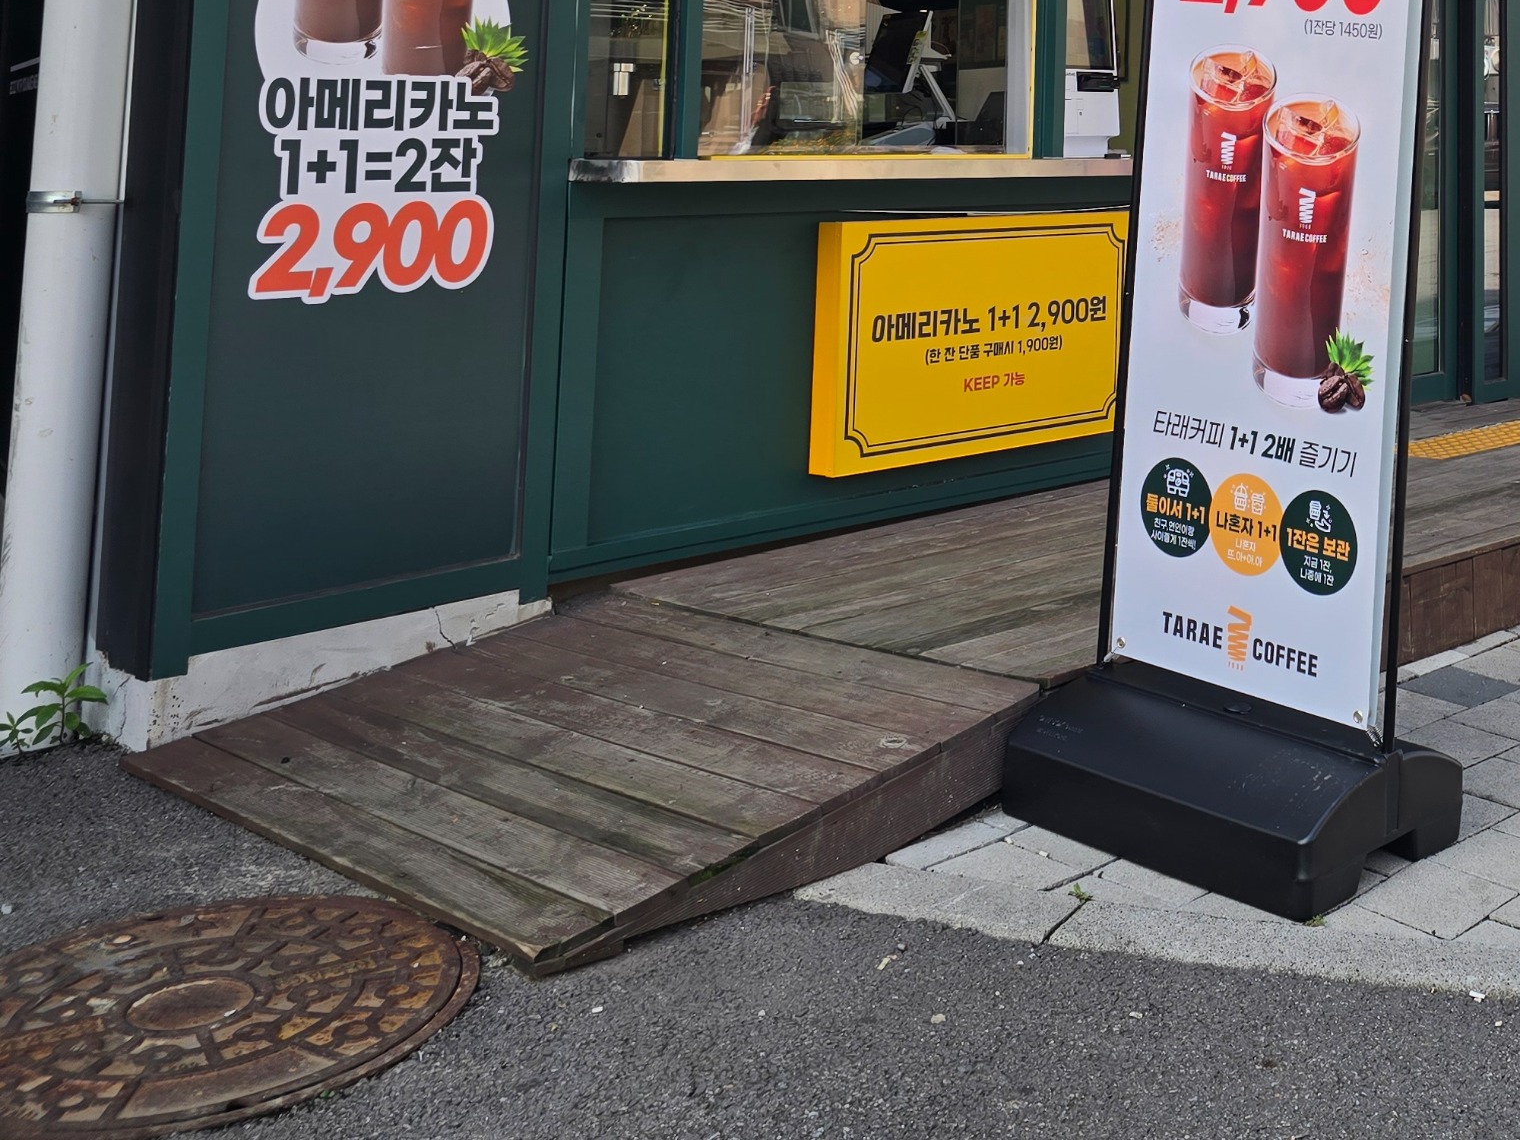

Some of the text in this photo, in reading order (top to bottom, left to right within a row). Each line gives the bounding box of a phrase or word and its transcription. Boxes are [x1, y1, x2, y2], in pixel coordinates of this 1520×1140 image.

[265, 77, 494, 131] 아메리카노
[280, 137, 477, 195] 1+1=2잔
[254, 199, 488, 298] 2,900
[871, 295, 1107, 343] 아메리카노 1+1 2,900원
[944, 347, 956, 363] 잔
[958, 344, 980, 361] 단품
[983, 340, 1014, 358] 구매시
[1018, 334, 1063, 356] 1,900원)
[963, 371, 1025, 393] KEEP 가능
[1153, 411, 1357, 478] 타래커피 1+1 2배 즐기기
[1186, 502, 1206, 525] 1+1
[1216, 511, 1277, 542] 나혼자 1+1
[1286, 527, 1351, 562] 1잔은 보관
[1303, 555, 1319, 569] 지금
[1162, 611, 1318, 678] TARAE COFFEE
